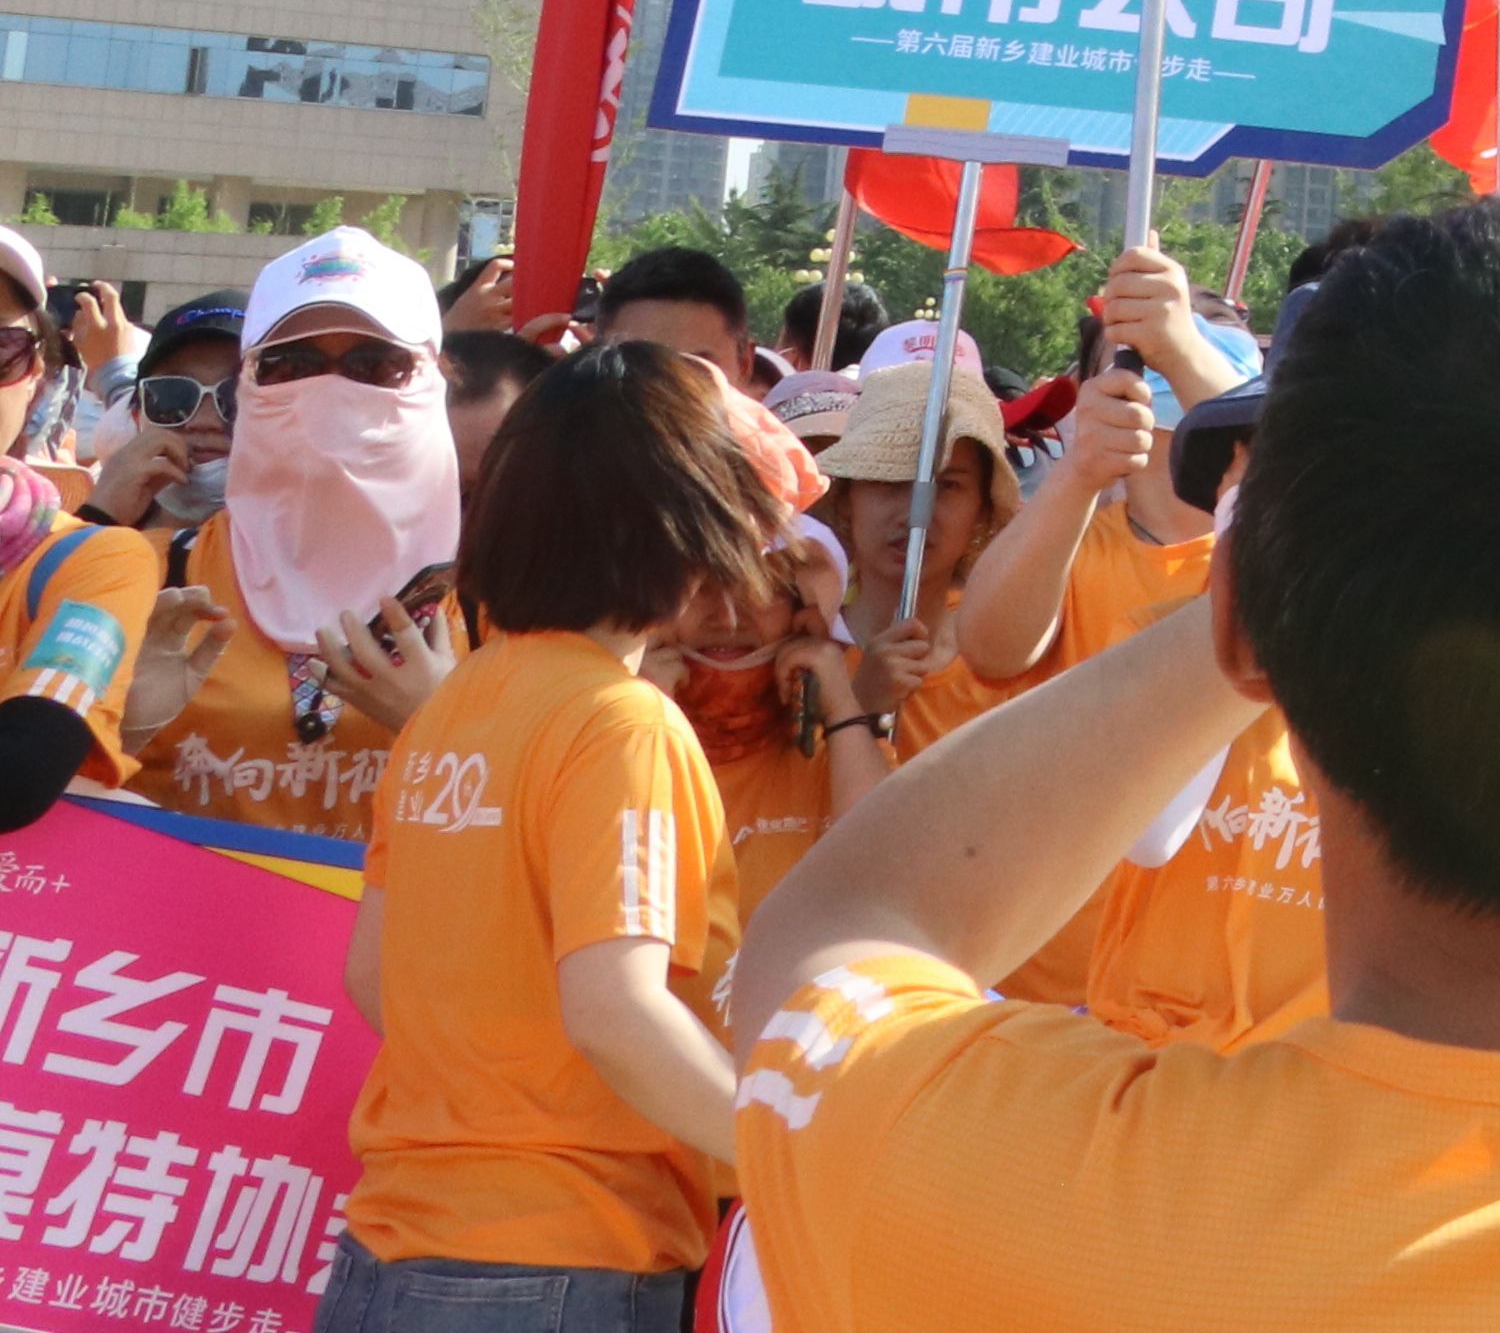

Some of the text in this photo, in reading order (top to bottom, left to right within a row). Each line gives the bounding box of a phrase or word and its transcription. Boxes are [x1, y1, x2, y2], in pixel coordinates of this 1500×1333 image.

[895, 28, 1213, 82] 第六届新乡建业城市步走
[0, 1101, 350, 1296] 模特协
